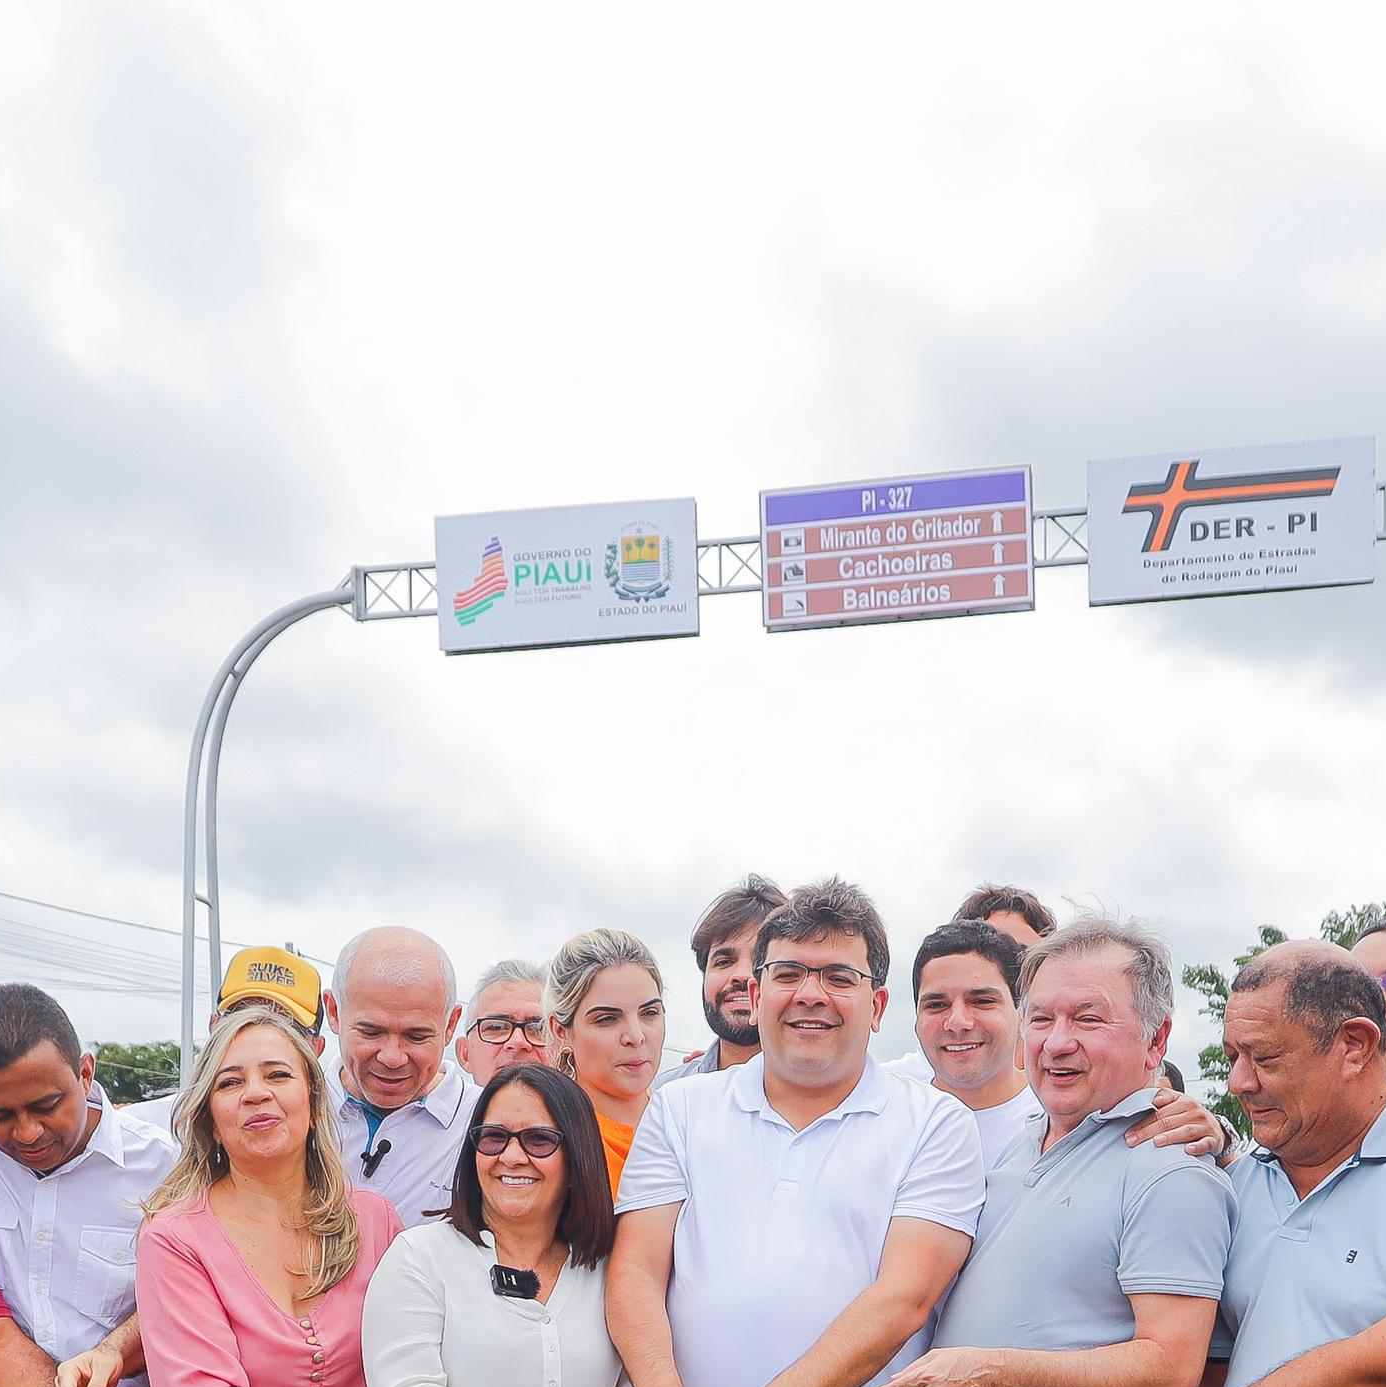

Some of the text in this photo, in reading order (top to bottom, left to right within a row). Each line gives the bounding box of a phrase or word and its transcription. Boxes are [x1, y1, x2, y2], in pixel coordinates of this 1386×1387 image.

[861, 490, 876, 512] PI
[888, 486, 913, 511] 327
[820, 514, 982, 549] Mirante do Gritador
[1190, 515, 1255, 542] DER
[1287, 511, 1318, 534] PI
[513, 547, 591, 562] GOVERNO DO
[839, 550, 953, 579] Cachoeiras
[1143, 546, 1317, 570] Departamento de Estradas
[514, 558, 592, 588] PIAUÍ
[1162, 563, 1298, 584] de Rodagem do Piauí
[843, 581, 951, 610] Balneários
[598, 602, 687, 617] ESTADO DO PIAUÍ
